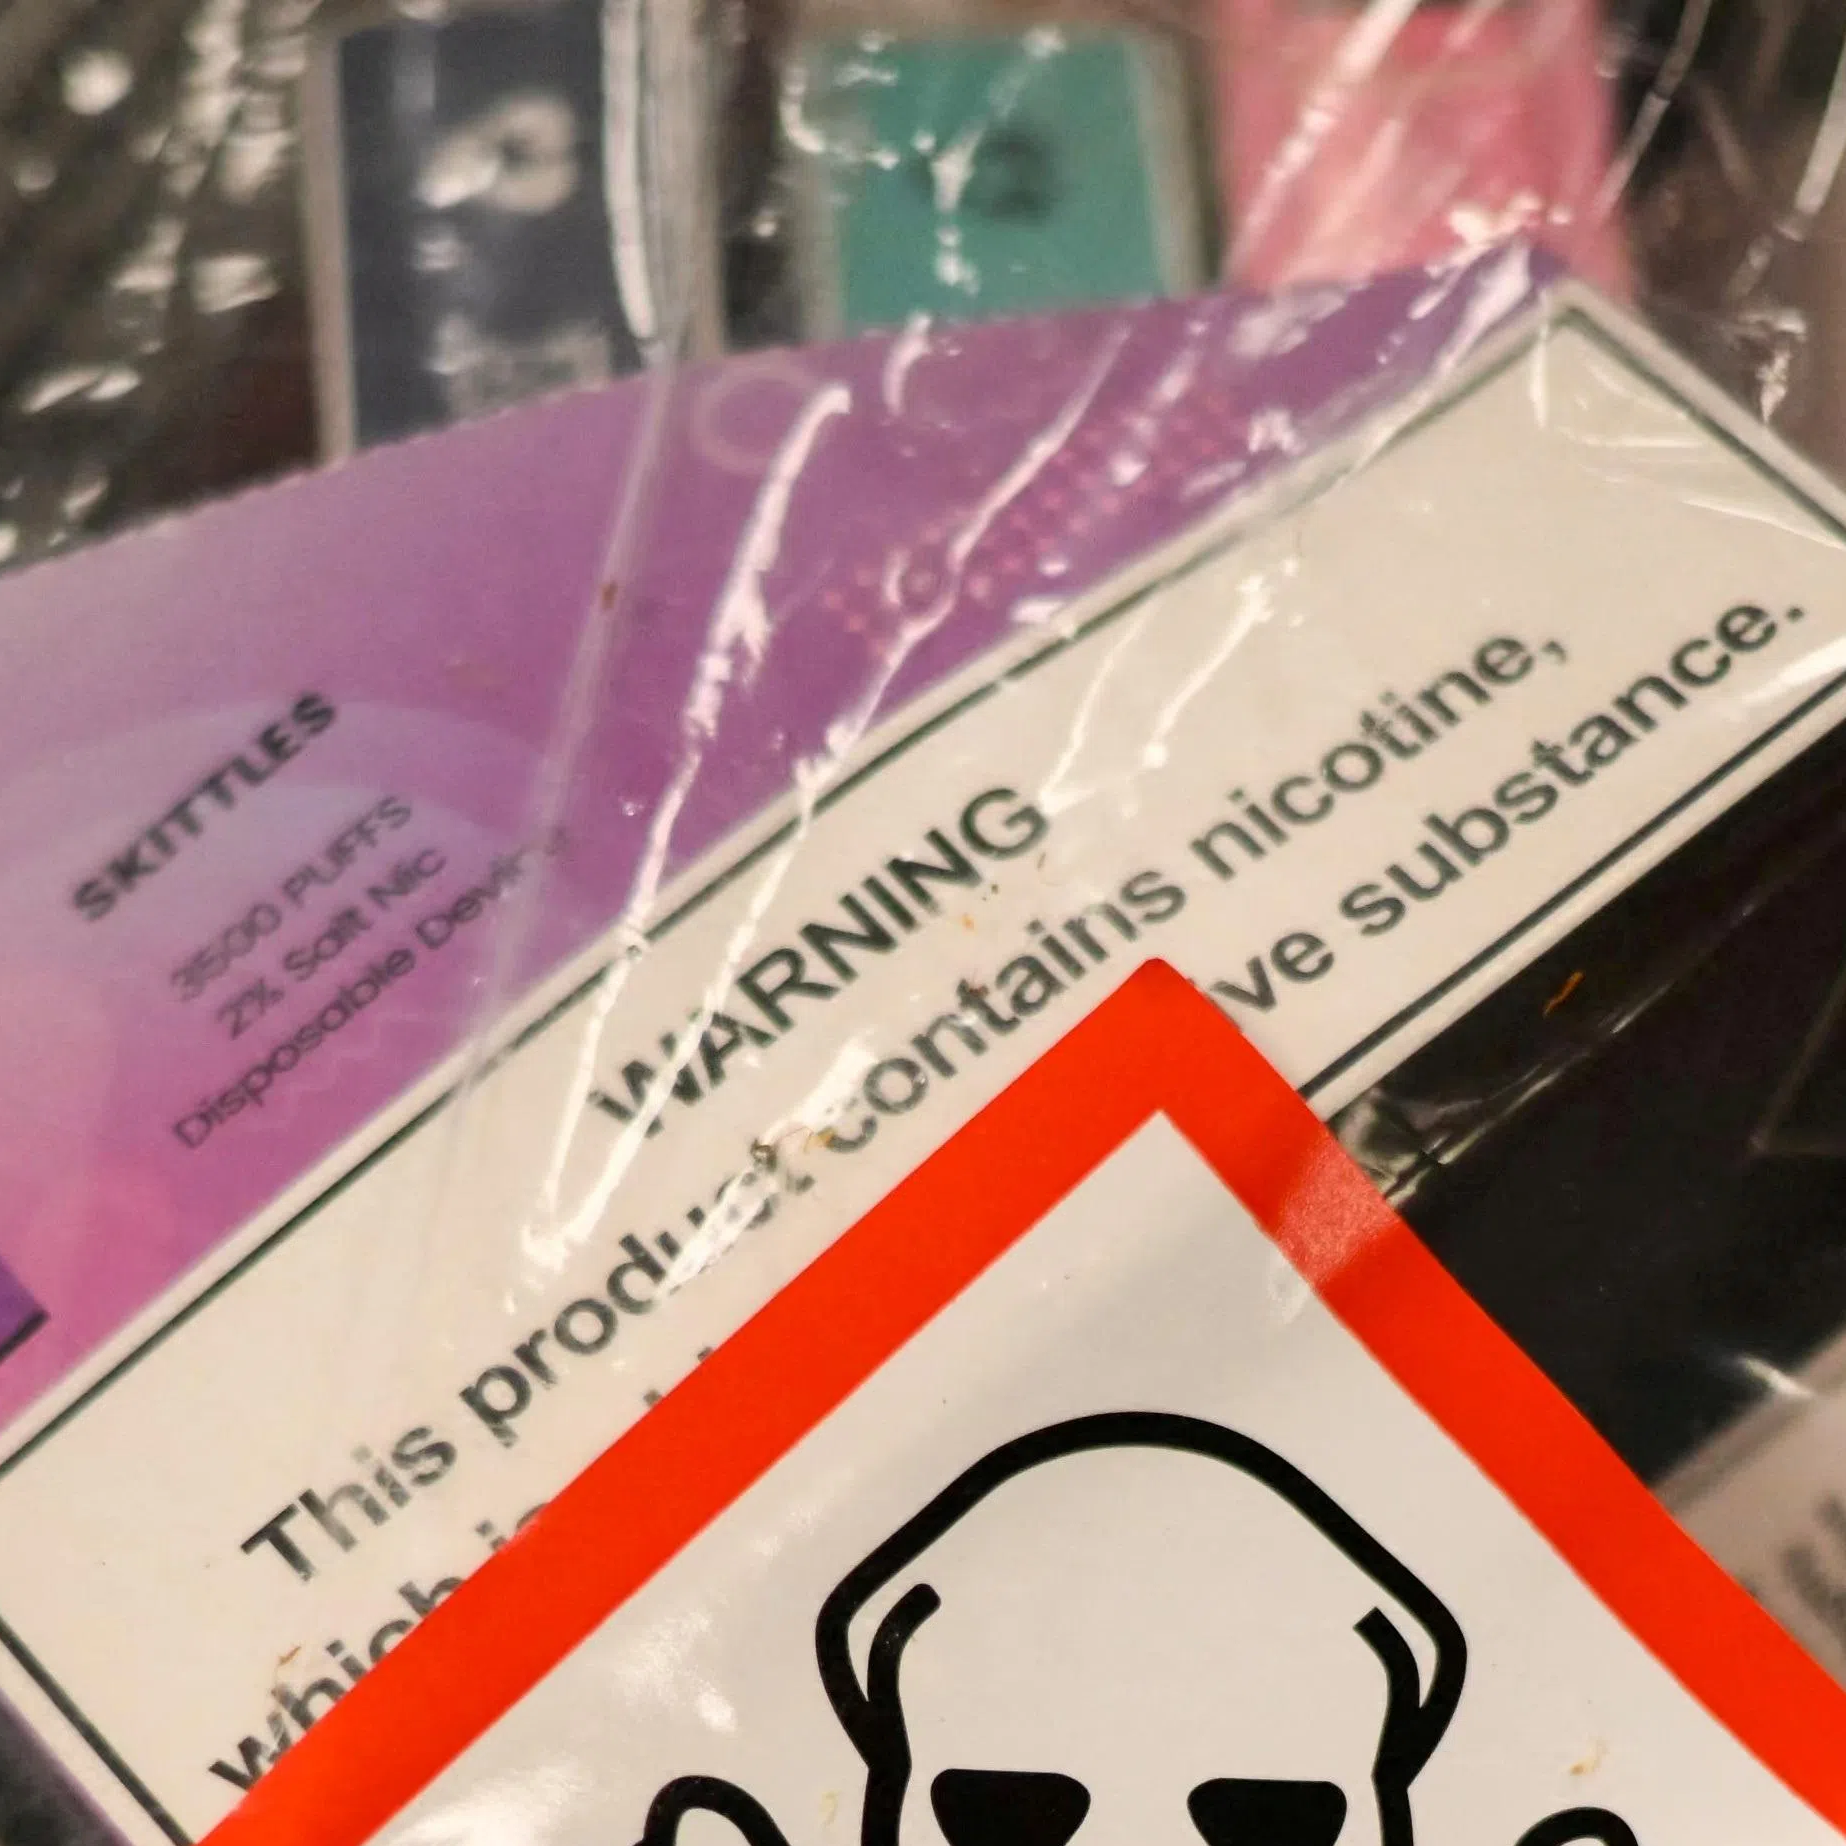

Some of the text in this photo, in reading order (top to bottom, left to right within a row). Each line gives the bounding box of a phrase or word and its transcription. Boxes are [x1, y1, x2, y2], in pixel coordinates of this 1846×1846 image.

[72, 692, 335, 920] SKITTLES
[1340, 592, 1806, 939] substance.
[170, 795, 413, 1002] 3500 PUFFS
[217, 848, 448, 1040] 2% Salt Nic
[588, 784, 1051, 1140] WARNING
[174, 947, 416, 1150] Disposable
[238, 629, 1570, 1585] This product contains nicotine,
